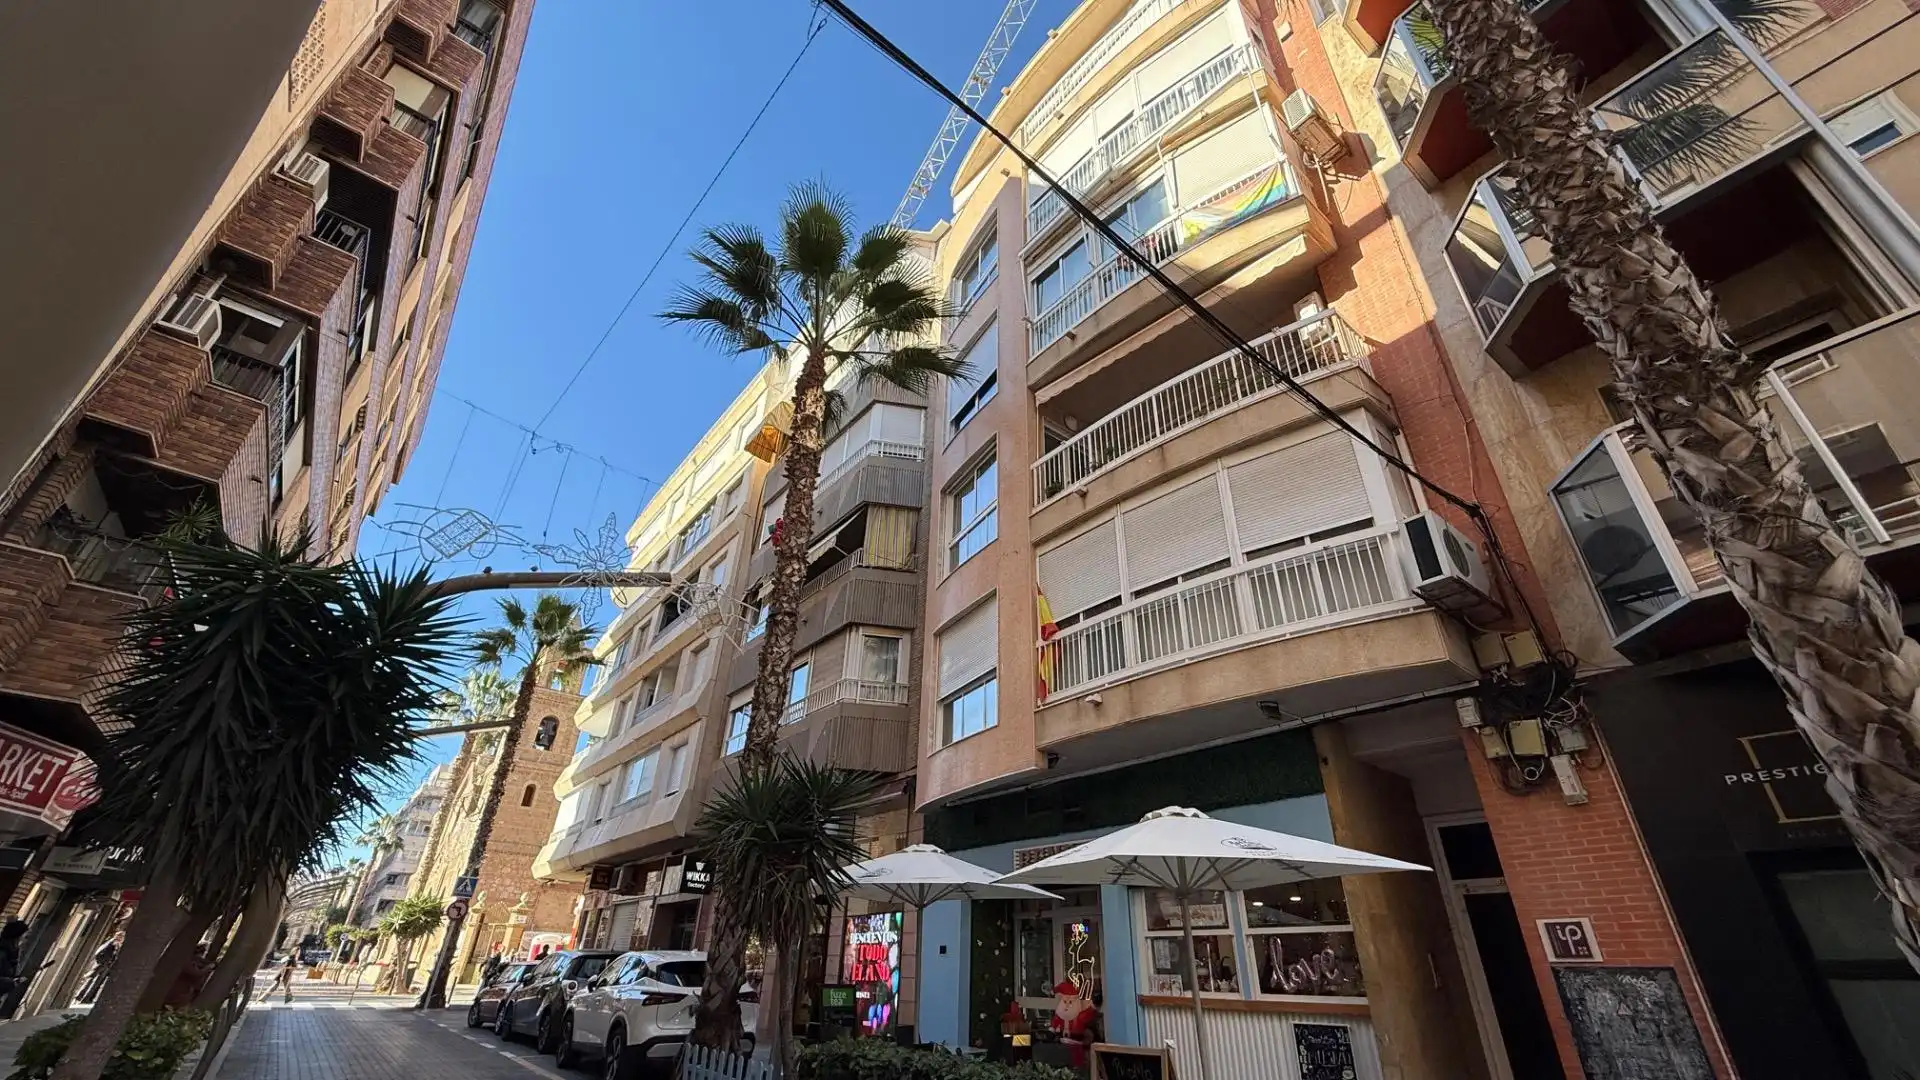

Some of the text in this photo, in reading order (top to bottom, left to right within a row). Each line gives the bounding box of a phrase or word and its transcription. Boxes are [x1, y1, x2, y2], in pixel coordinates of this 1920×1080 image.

[0, 739, 68, 794] RKET
[1724, 763, 1828, 785] PRESTIG
[686, 871, 711, 882] WIKKA
[858, 944, 888, 961] TODO
